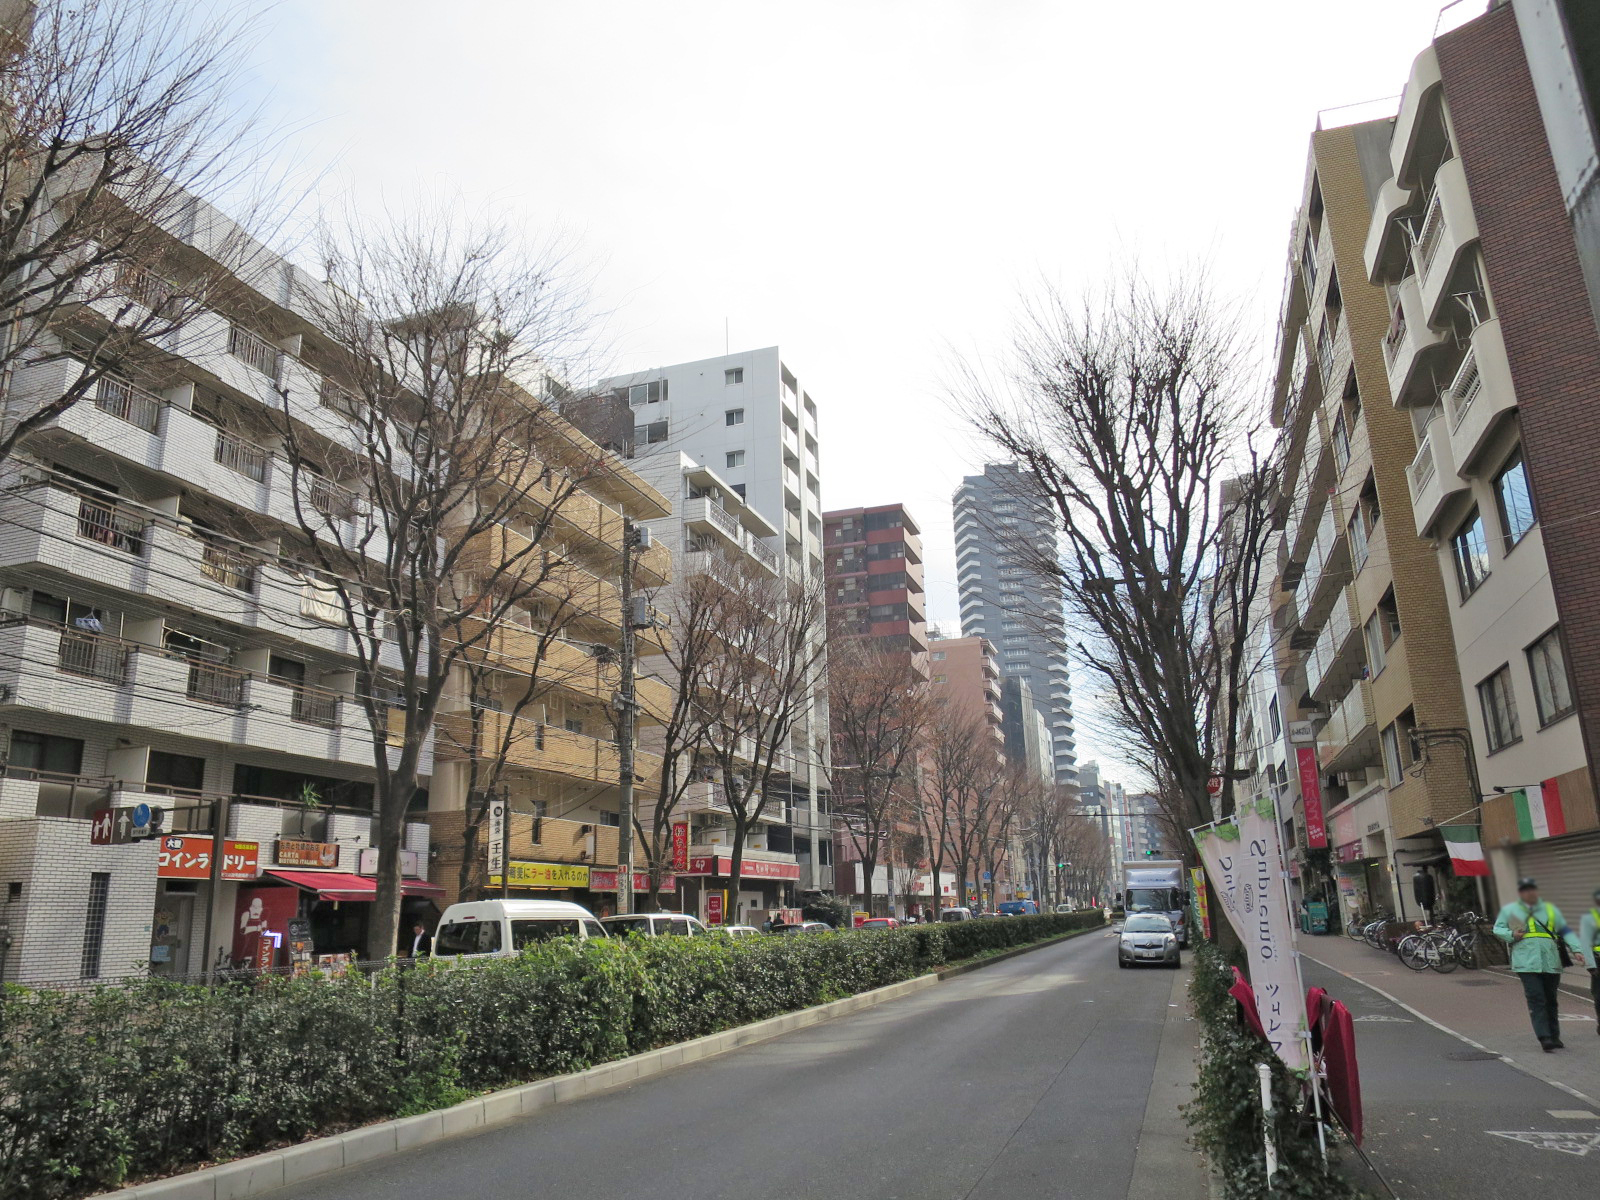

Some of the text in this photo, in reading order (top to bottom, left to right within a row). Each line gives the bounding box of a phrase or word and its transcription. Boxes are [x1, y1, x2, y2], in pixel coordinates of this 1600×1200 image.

[158, 852, 256, 870] コインラドリー
[279, 851, 299, 859] CARTA
